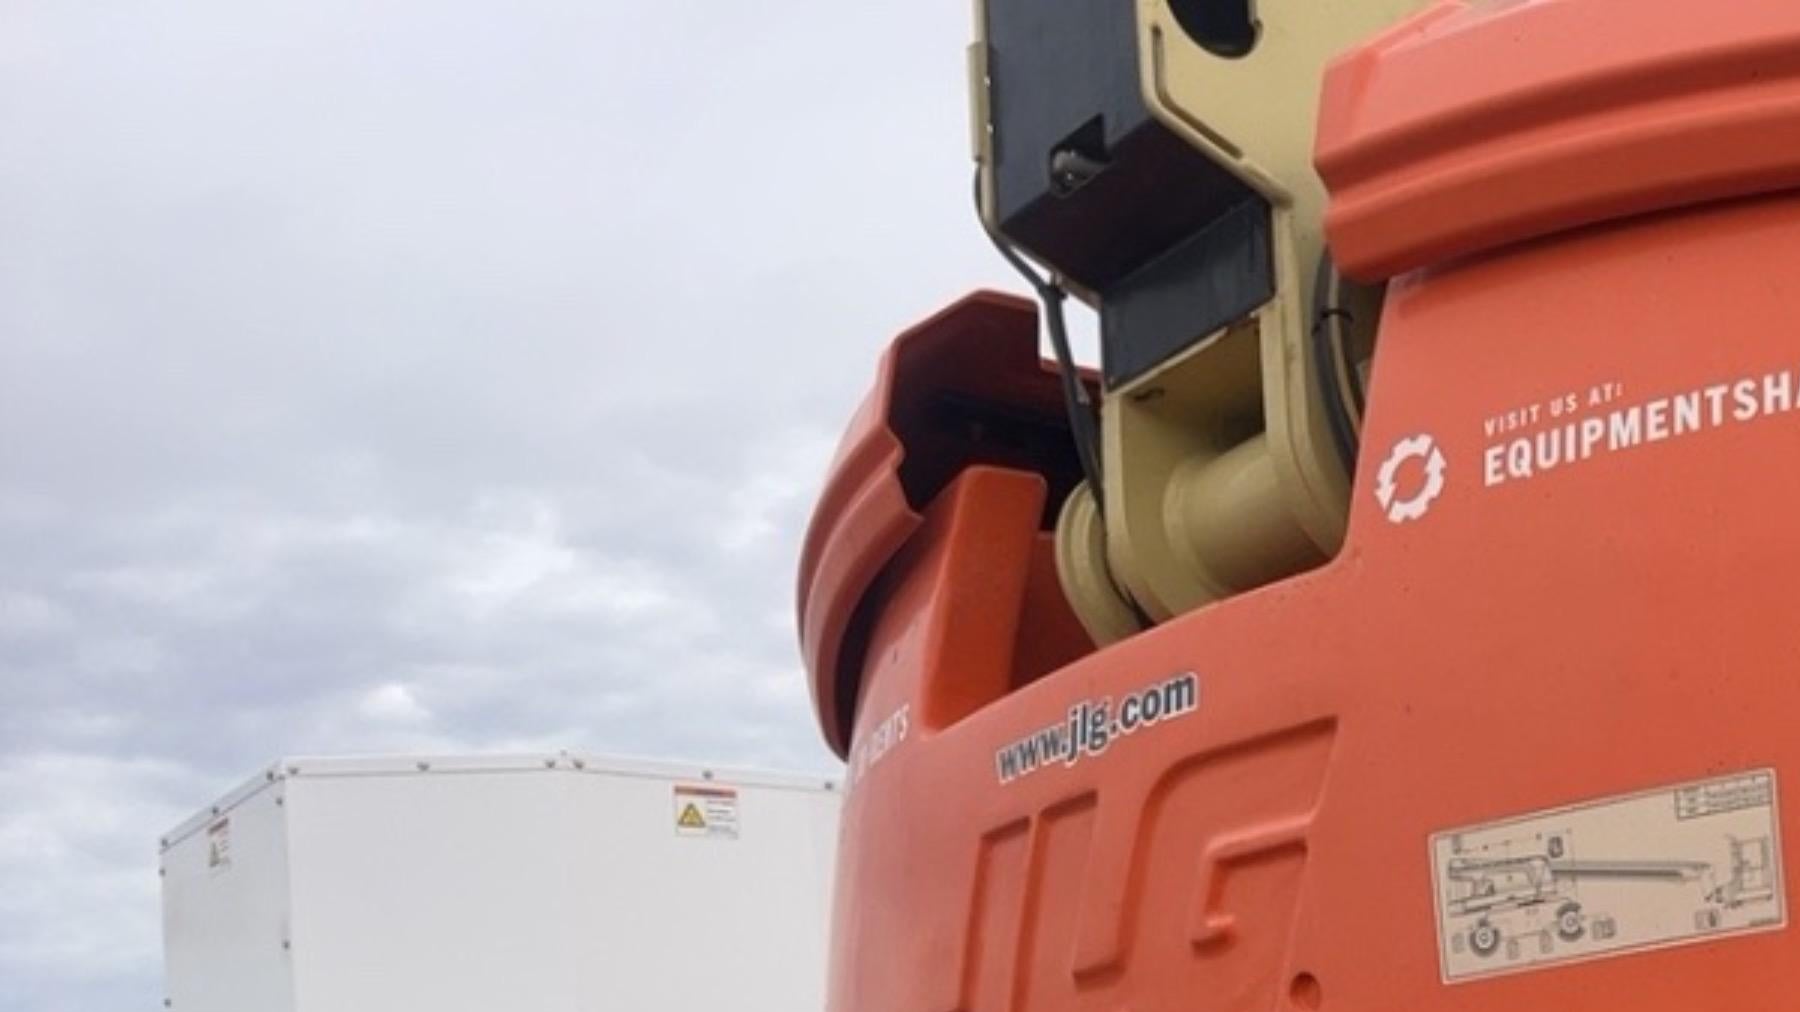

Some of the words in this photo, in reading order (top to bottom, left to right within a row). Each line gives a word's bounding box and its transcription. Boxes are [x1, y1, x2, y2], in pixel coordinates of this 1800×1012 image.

[1484, 404, 1541, 437] VISIT
[1550, 392, 1578, 418] US
[1589, 382, 1622, 408] AT:
[996, 671, 1198, 784] www.jlg.com
